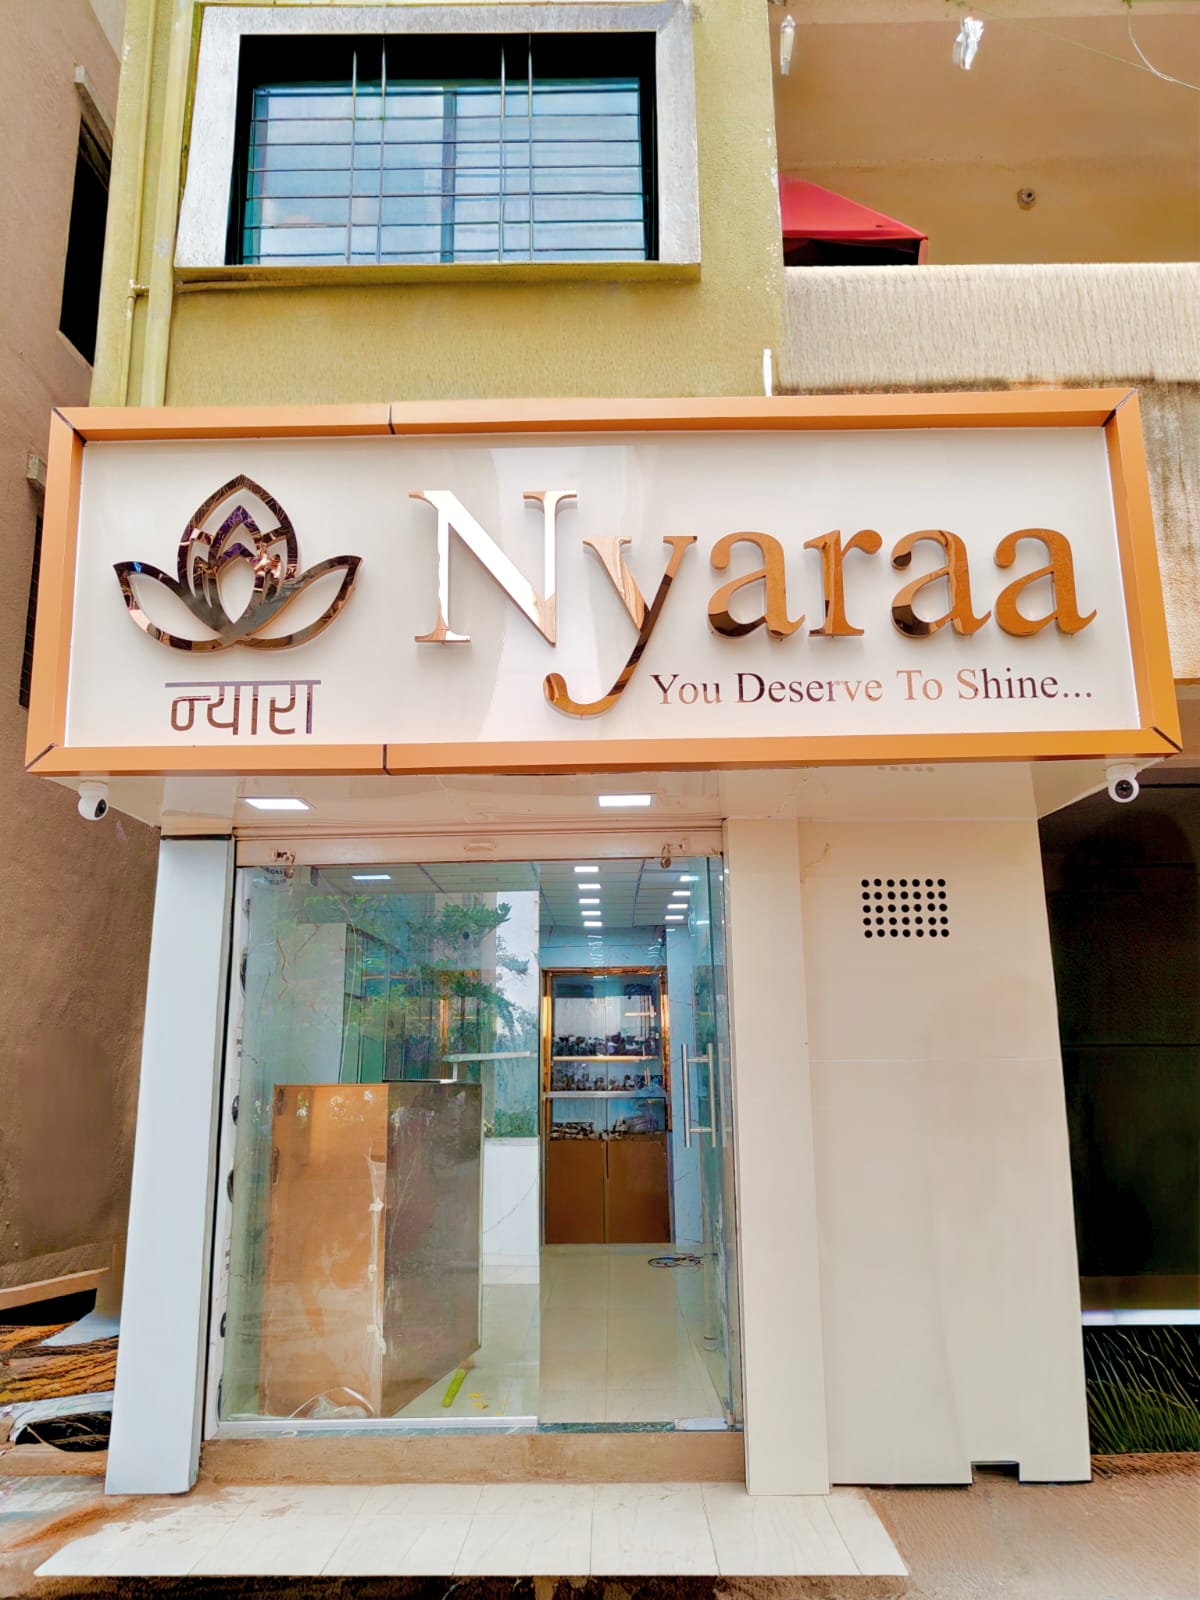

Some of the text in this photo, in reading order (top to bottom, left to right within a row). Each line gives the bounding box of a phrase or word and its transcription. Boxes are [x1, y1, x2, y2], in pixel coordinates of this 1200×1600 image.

[408, 490, 1097, 718] Nyaraa
[164, 679, 321, 736] न्यारा
[650, 667, 1093, 705] You Deserve To Shine...
